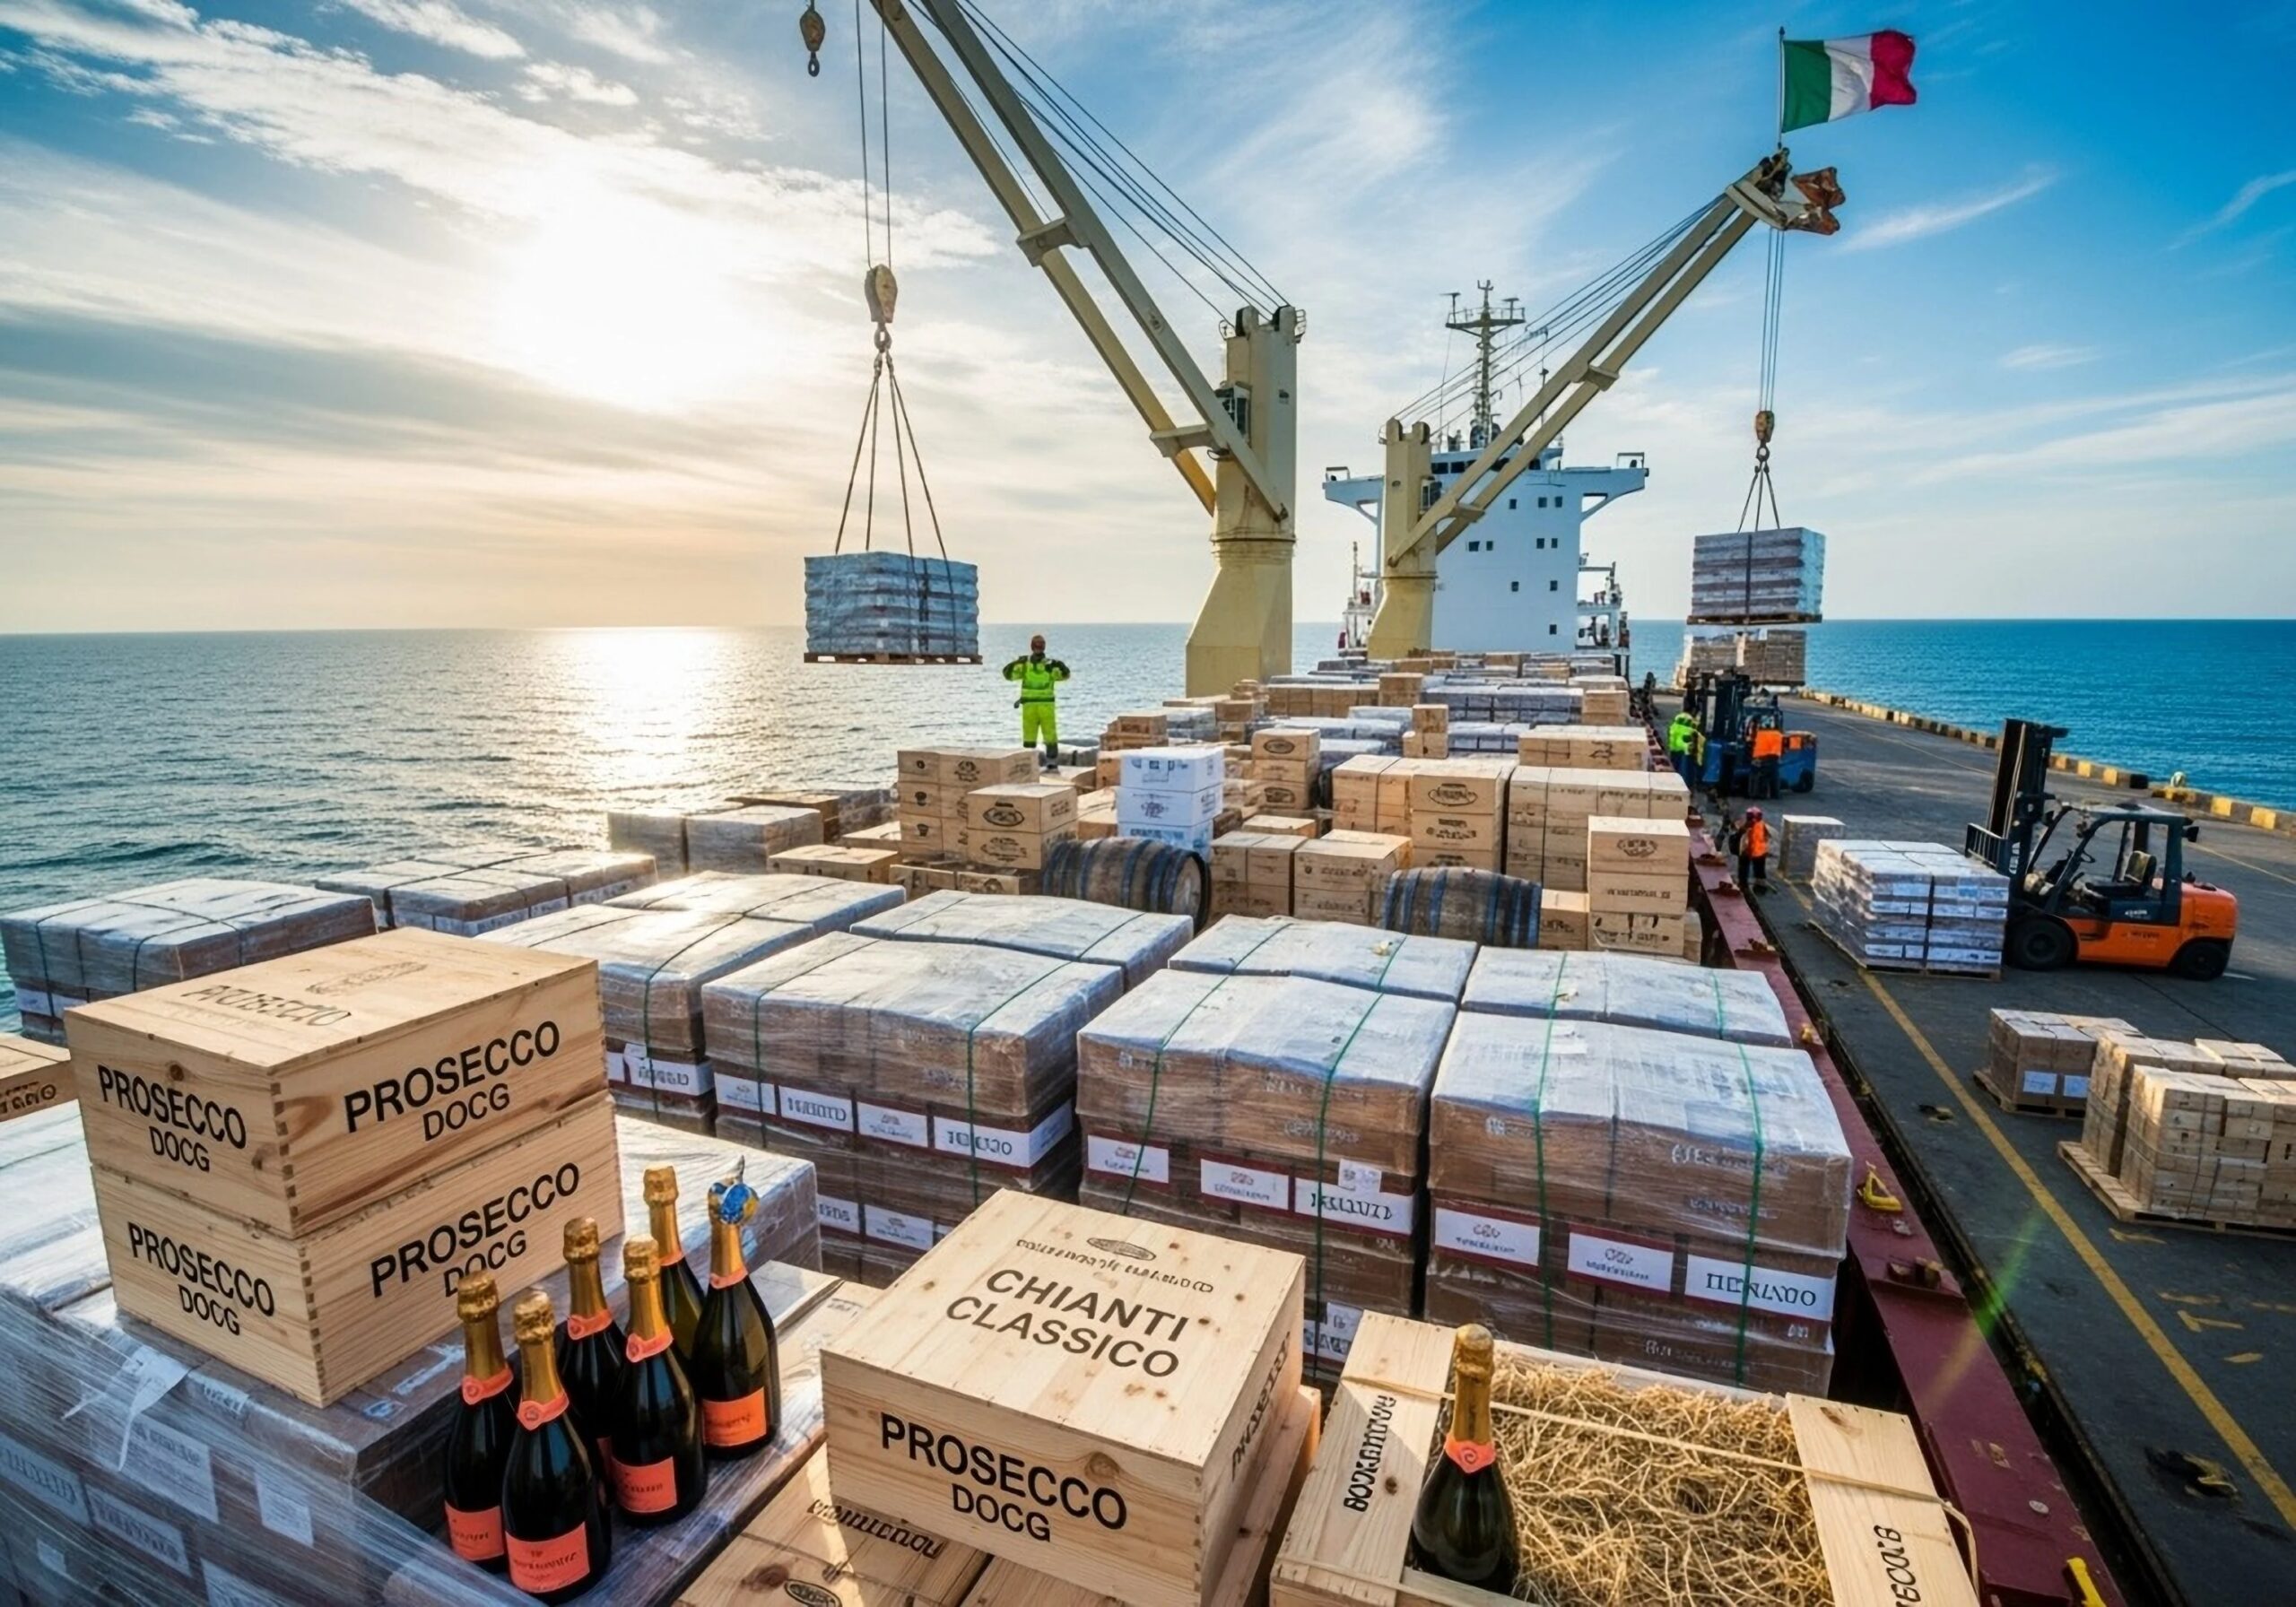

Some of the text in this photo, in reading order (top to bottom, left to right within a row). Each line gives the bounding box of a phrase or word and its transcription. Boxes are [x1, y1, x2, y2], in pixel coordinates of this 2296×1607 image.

[98, 1065, 247, 1149] PROSECCO
[344, 1021, 560, 1133] PROSECCO
[422, 1083, 510, 1140] DOCG
[149, 1126, 210, 1172] DOCG
[127, 1222, 274, 1317] PROSECCO
[371, 1163, 579, 1298] PROSECCO
[179, 1284, 239, 1336] DOCG
[946, 1296, 1179, 1377] CLASSICO
[987, 1269, 1188, 1342] CHIANTI
[881, 1412, 1127, 1529] PROSECCO
[952, 1484, 1051, 1542] DOCG
